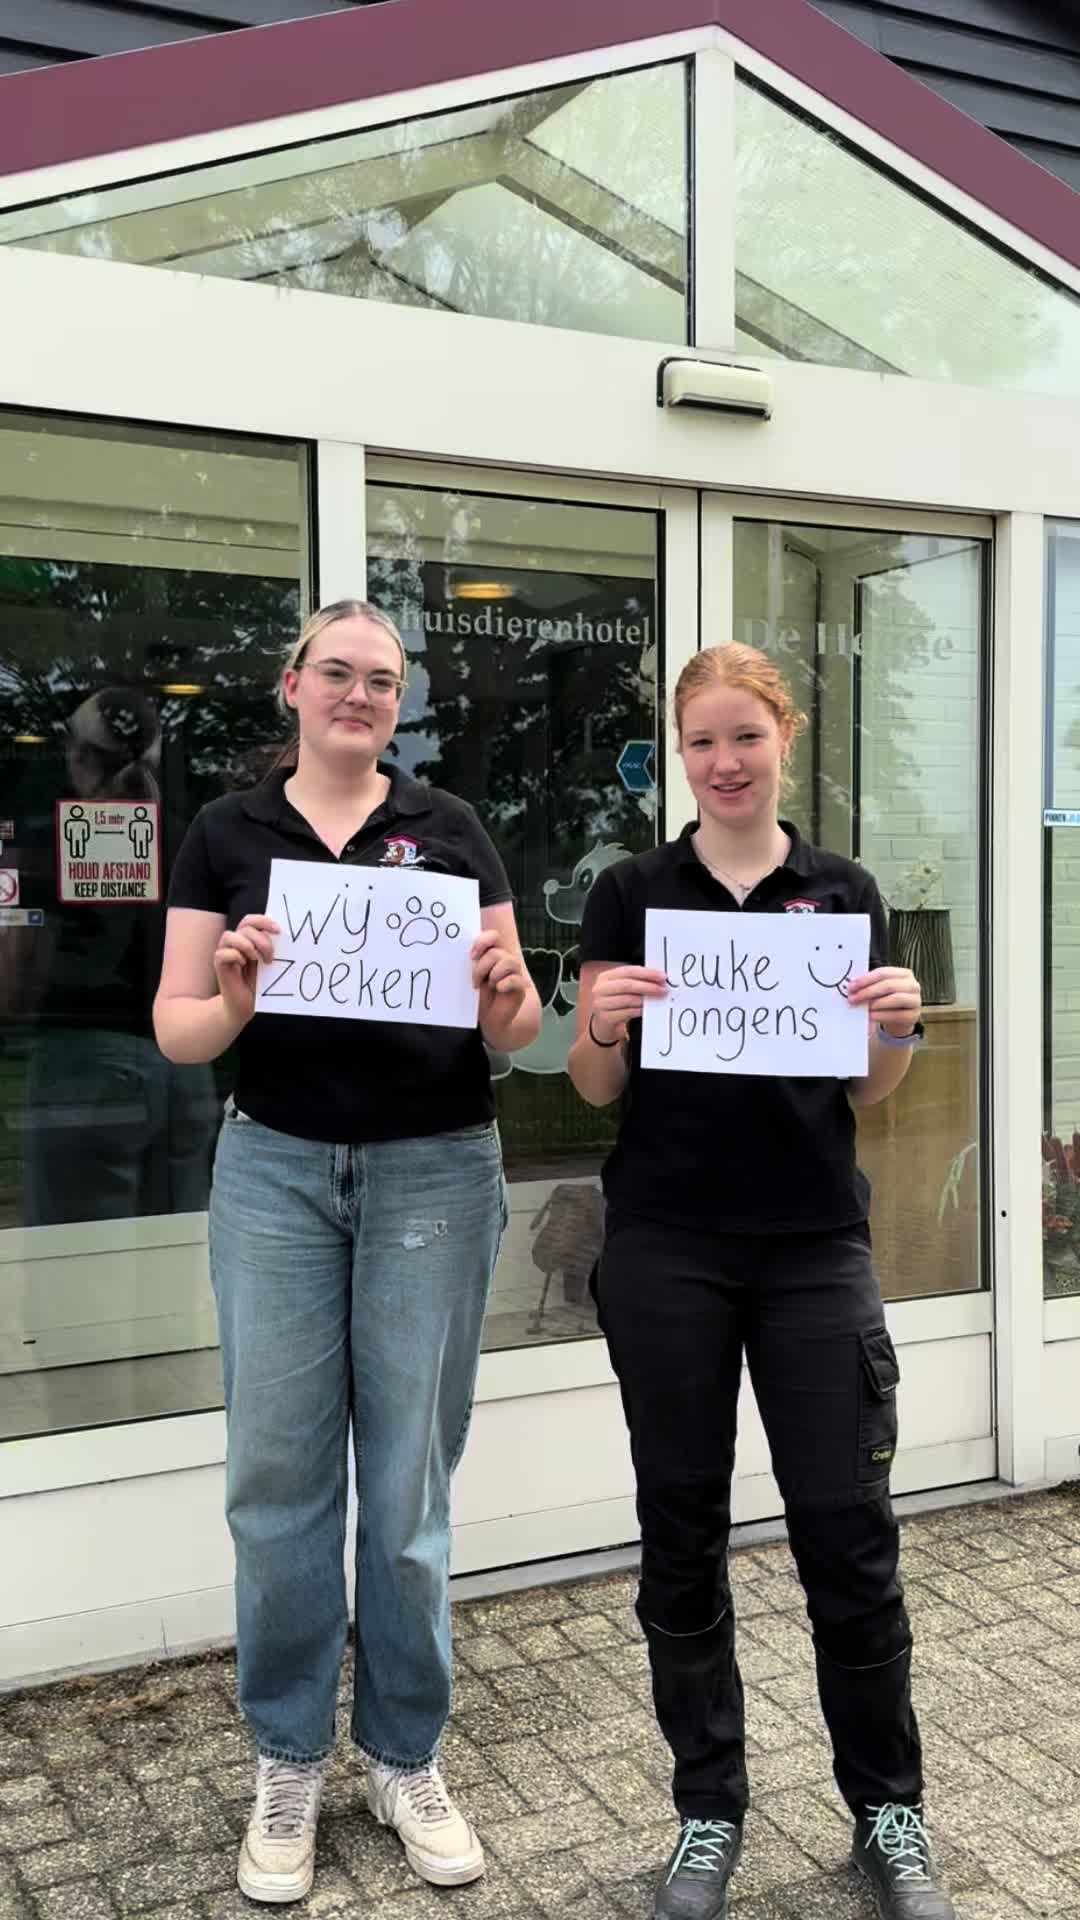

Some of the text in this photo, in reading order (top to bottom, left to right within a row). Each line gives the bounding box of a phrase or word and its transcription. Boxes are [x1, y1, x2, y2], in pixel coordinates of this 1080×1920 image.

[68, 862, 151, 880] HOUD AFSTAND
[74, 882, 146, 898] KEEP DISTANCE
[663, 936, 779, 992] leuke
[659, 998, 818, 1062] jongens
